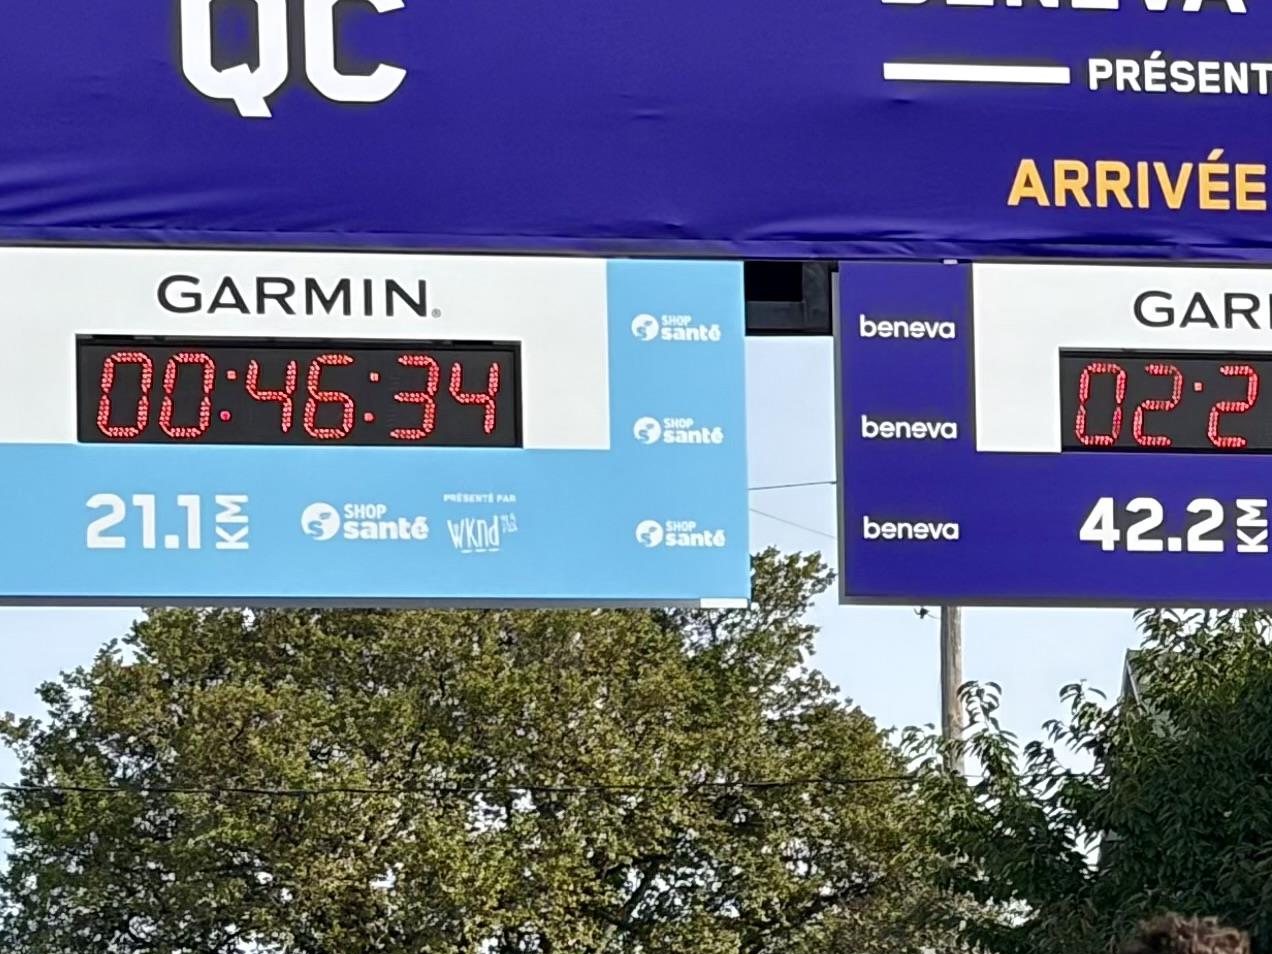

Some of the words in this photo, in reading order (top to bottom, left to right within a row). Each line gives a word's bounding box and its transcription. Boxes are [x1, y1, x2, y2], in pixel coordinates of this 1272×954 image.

[181, 0, 407, 118] QC
[1008, 149, 1267, 211] ARRIVÉE
[157, 274, 429, 318] GARMIN
[660, 323, 721, 342] santé
[661, 314, 692, 327] SHOP
[859, 315, 955, 341] beneva
[97, 352, 499, 440] 00:46:34
[663, 417, 694, 429] SHOP
[663, 426, 724, 445] santé
[861, 416, 957, 441] beneva
[86, 493, 201, 549] 21.1
[215, 494, 249, 549] KM
[343, 504, 387, 520] SHOP
[343, 516, 430, 541] santé
[665, 520, 696, 532] SHOP
[863, 518, 960, 541] beneva
[1079, 497, 1225, 553] 42.2
[1237, 498, 1269, 553] KM
[665, 529, 726, 548] santé
